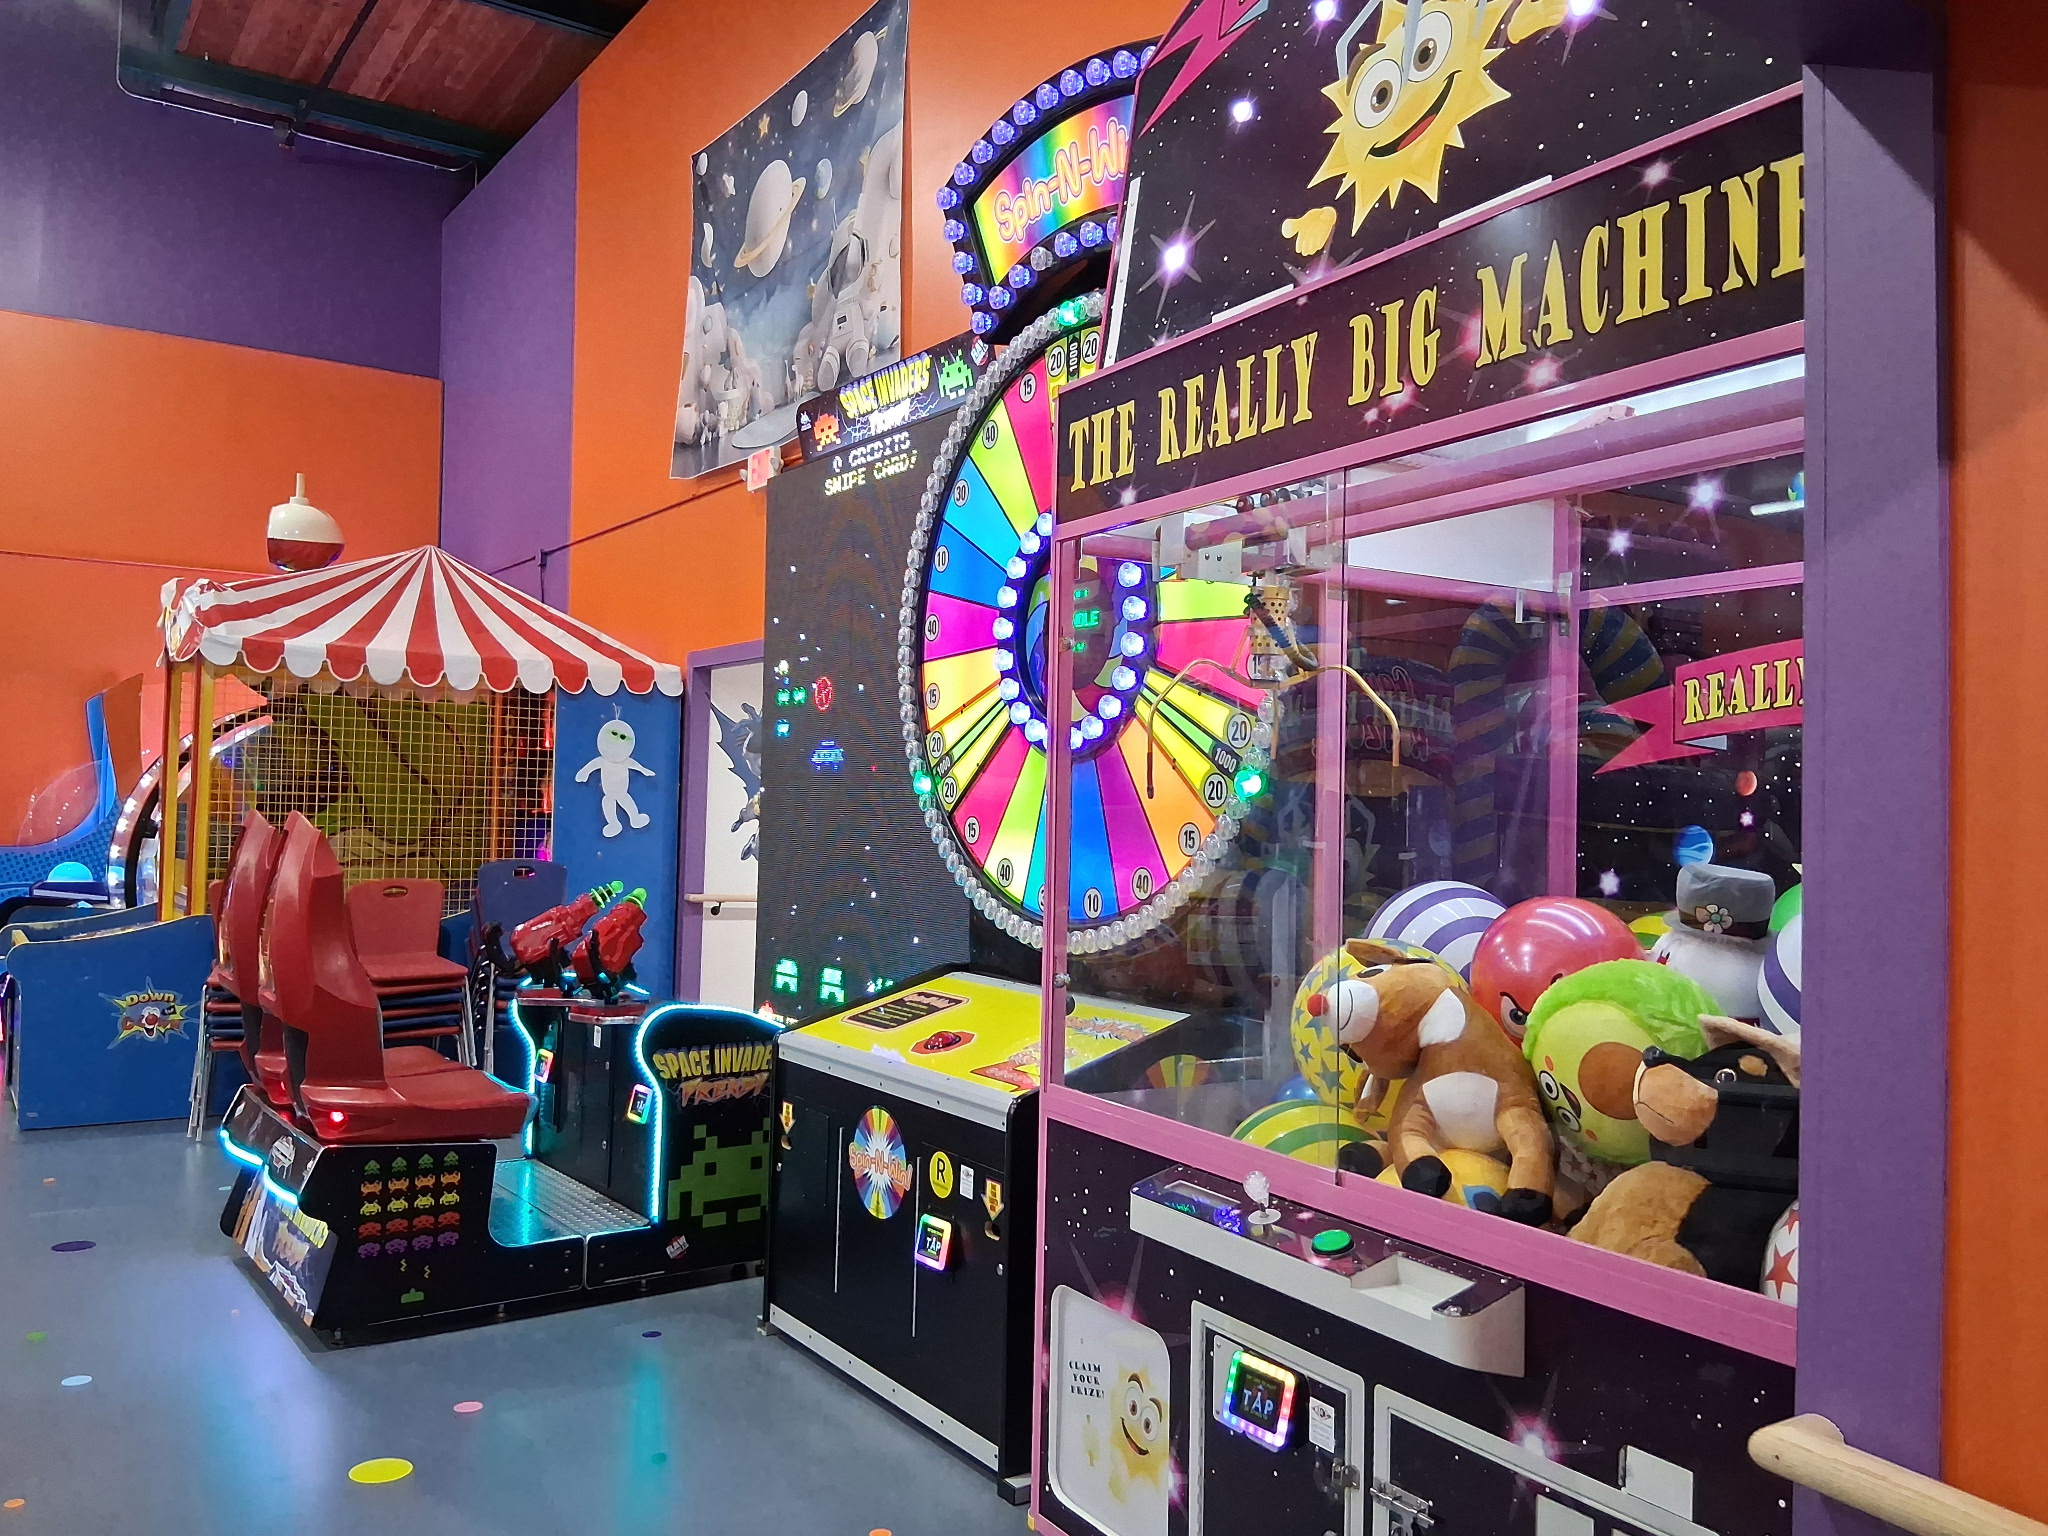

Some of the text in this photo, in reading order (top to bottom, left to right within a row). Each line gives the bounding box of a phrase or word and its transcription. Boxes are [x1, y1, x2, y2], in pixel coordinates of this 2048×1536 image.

[994, 118, 1127, 241] Spin-N-Wi
[1069, 152, 1804, 493] THE REALLY BIG MACHINE
[1070, 342, 1078, 372] 1000
[1085, 337, 1097, 358] 20
[1050, 351, 1062, 372] 20
[839, 355, 931, 419] SPACE INVADERS
[1023, 378, 1033, 396] 15
[985, 426, 996, 442] 40
[848, 431, 911, 467] CREDITS
[824, 449, 918, 496] SWIPE CARD!
[956, 485, 967, 501] 30
[937, 552, 946, 566] 10
[927, 620, 936, 635] 40
[929, 688, 937, 703] 15
[1231, 721, 1247, 742] 20
[931, 737, 941, 752] 20
[937, 757, 951, 776] 1000
[1214, 748, 1237, 773] 1000
[944, 782, 955, 798] 20
[1208, 781, 1223, 801] 20
[968, 823, 976, 838] 15
[1184, 830, 1195, 849] 15
[1000, 864, 1011, 881] 40
[1136, 874, 1149, 894] 40
[1087, 895, 1099, 911] 10
[125, 992, 176, 1007] Down
[653, 1043, 773, 1079] SPACE INVADE
[849, 1142, 913, 1191] Spin-N-Win!
[936, 1158, 946, 1183] R
[926, 1236, 941, 1251] TAP
[1069, 1360, 1101, 1372] CLAIM
[1073, 1373, 1101, 1385] YOUR
[1071, 1385, 1104, 1399] PRIZE!
[1243, 1387, 1274, 1415] TAP
